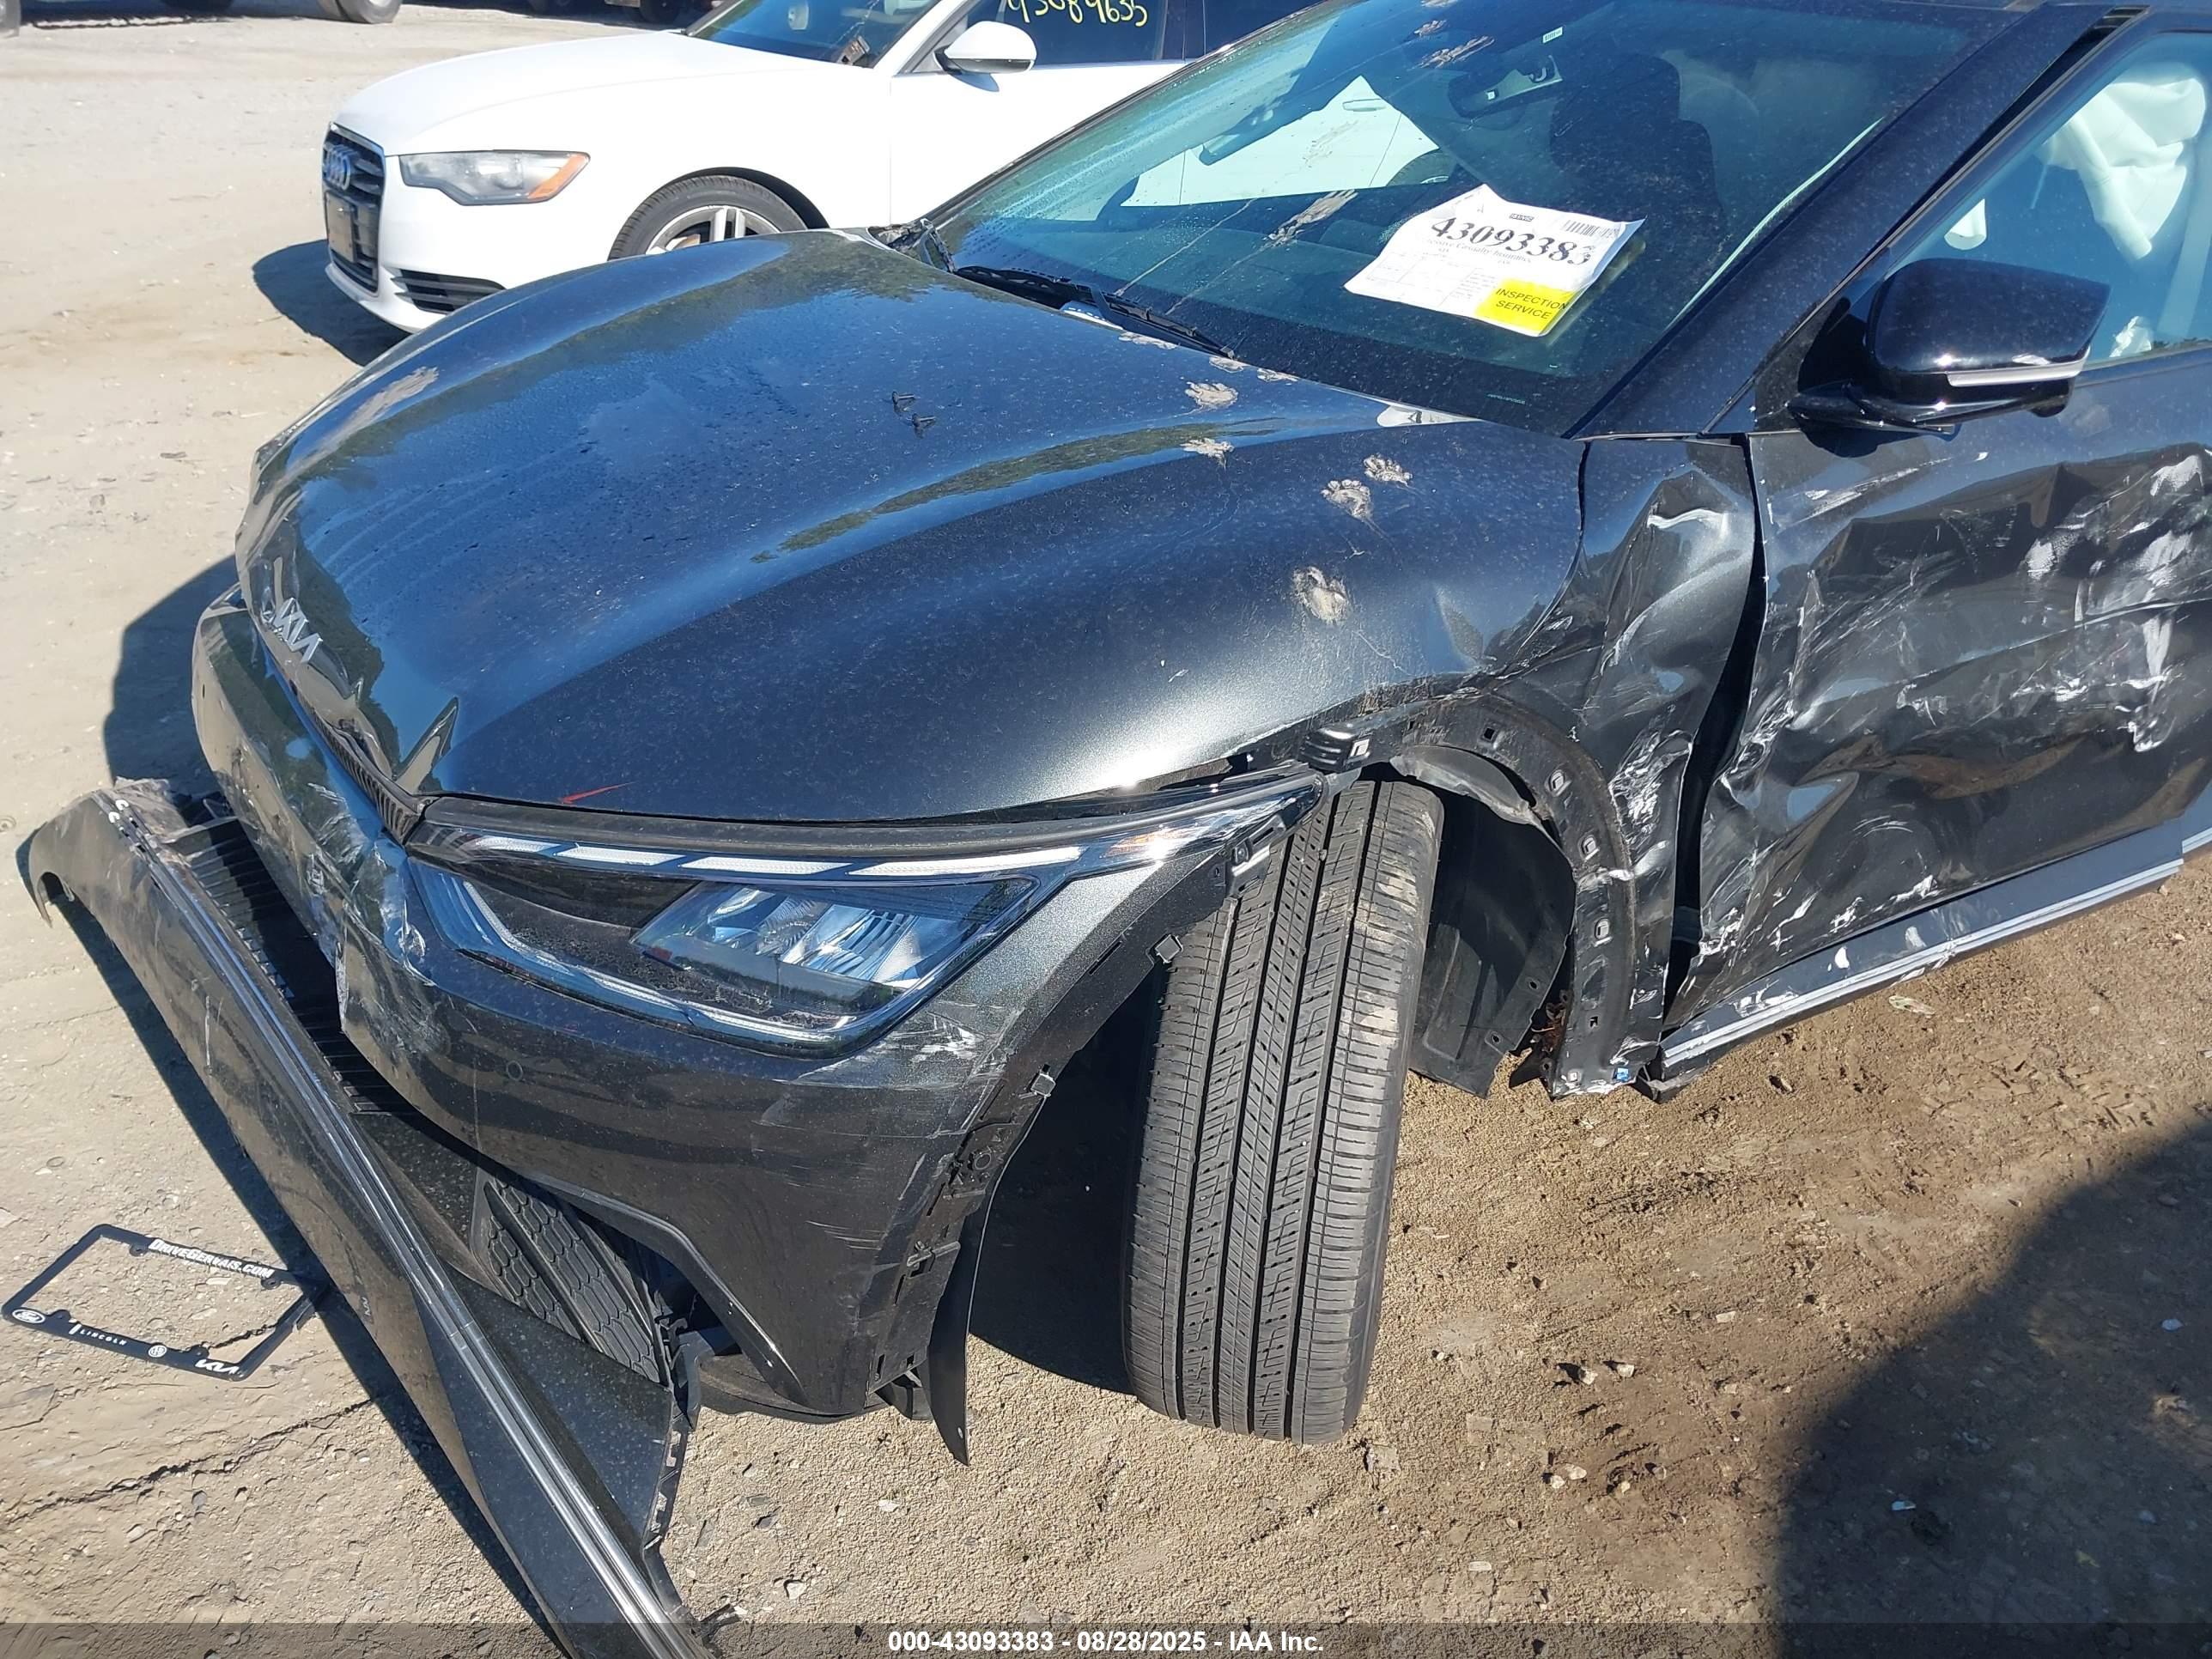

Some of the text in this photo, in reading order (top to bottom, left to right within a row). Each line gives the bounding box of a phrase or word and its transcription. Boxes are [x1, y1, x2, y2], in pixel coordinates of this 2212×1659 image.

[1431, 217, 1595, 265] 43093383
[1496, 287, 1570, 311] INSPECTION
[1496, 299, 1553, 320] SERVICE
[80, 1329, 128, 1346] LINCOLN
